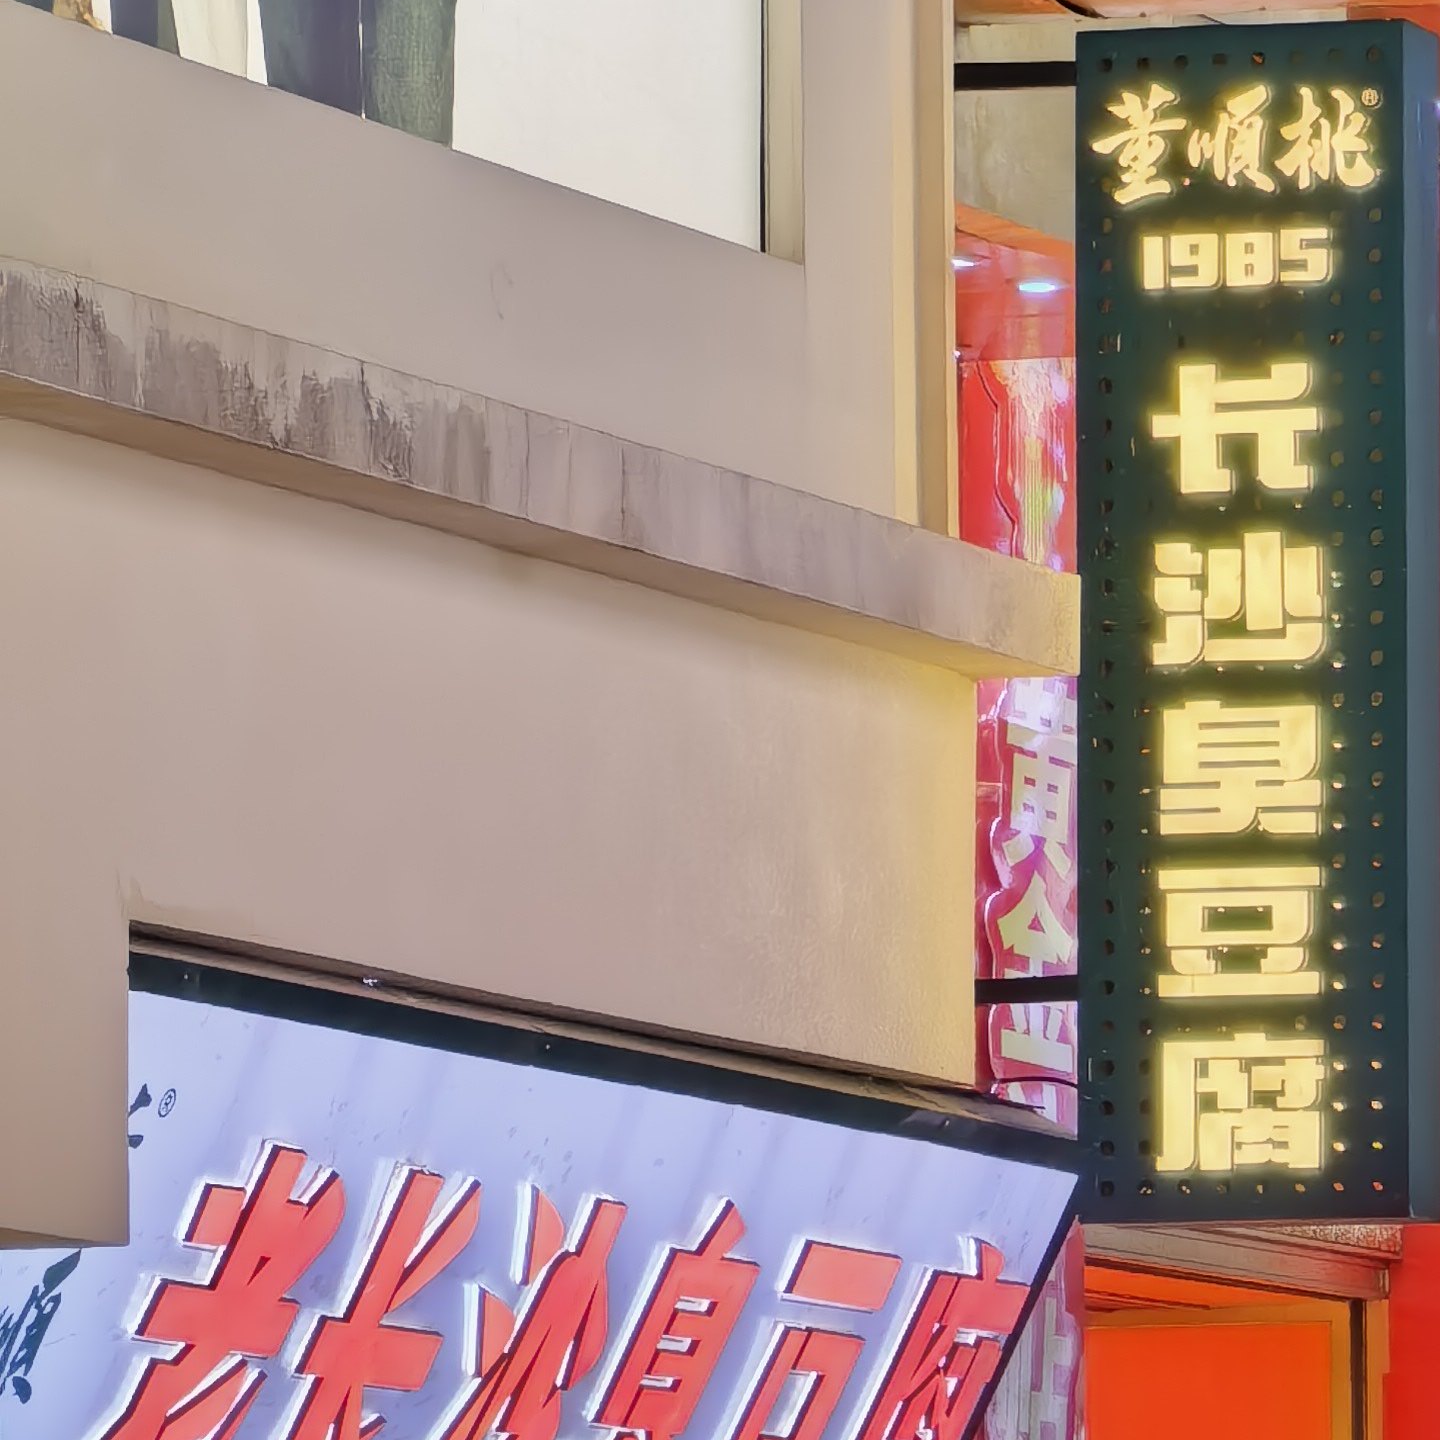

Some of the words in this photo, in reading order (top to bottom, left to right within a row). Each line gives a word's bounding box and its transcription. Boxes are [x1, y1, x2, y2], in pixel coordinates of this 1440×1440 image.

[1141, 225, 1335, 291] 1985
[1150, 362, 1327, 1174] 长沙臭豆腐
